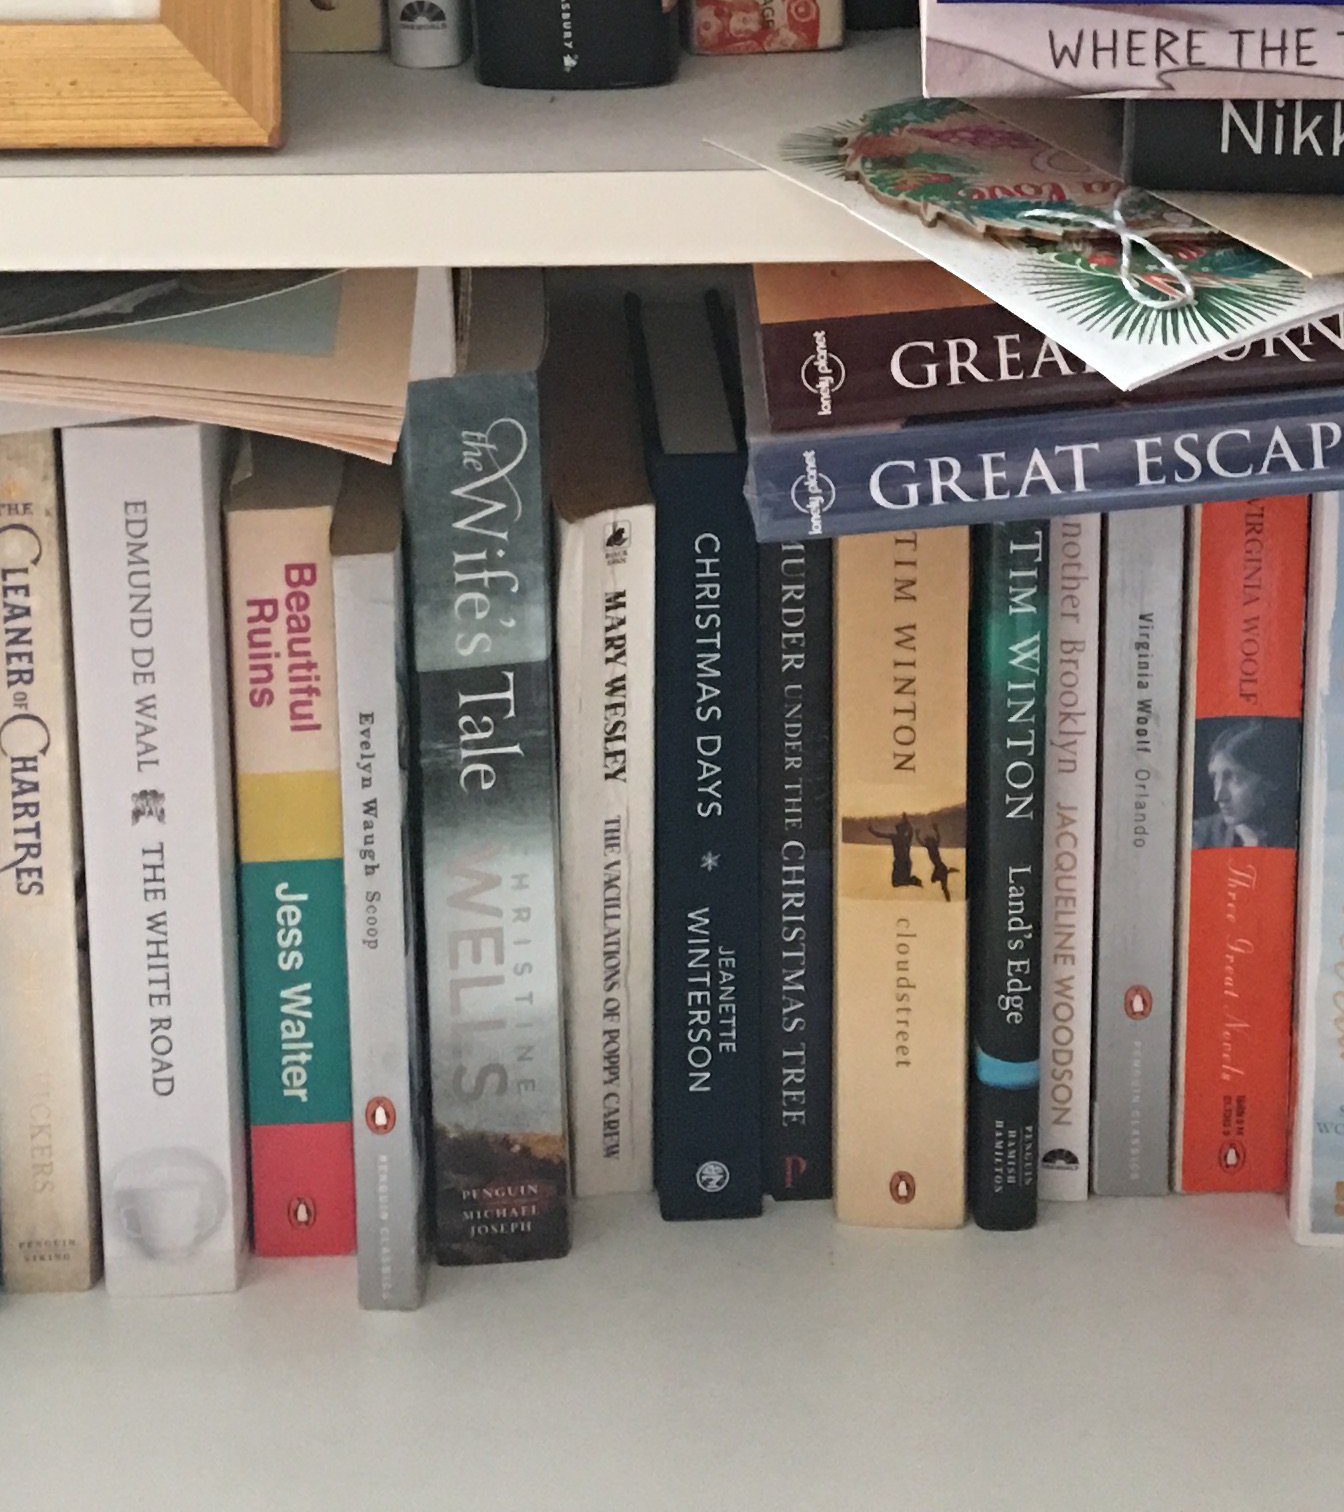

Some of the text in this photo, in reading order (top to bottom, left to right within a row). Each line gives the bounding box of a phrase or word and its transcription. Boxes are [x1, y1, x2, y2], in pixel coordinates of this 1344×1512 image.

[1048, 27, 1208, 71] WHERE
[1229, 27, 1319, 69] THE
[868, 439, 1102, 512] GREAT
[124, 499, 160, 773] EDMUND DE WAAL
[246, 597, 282, 709] Ruins
[284, 562, 323, 733] Beautiful
[604, 588, 627, 667] MARY
[694, 532, 722, 818] CHRISTMAS DAYS
[892, 532, 918, 774] TIM WINTON
[1006, 530, 1043, 820] TIM WINTON
[456, 670, 526, 794] Tale
[603, 674, 627, 785] WESLEY
[1049, 639, 1087, 775] Brooklyn
[1133, 611, 1155, 849] Virginia Woolf Orlando
[358, 711, 382, 951] Evelyn Waugh Scoop
[780, 683, 806, 1128] UNDER THE CHRISTMAS TREE
[142, 843, 175, 1097] THE WHITE ROAD
[275, 881, 314, 1104] Jess Walter
[602, 859, 622, 1161] VACILLATIONS POPPY CAREW
[687, 906, 712, 1093] WINTERSON
[717, 945, 738, 1053] JEANETTE
[894, 916, 917, 1069] cloudstreet
[997, 958, 1031, 1025] Edge
[1050, 974, 1076, 1127] WOODSON
[461, 1183, 539, 1200] PENGUIN
[462, 1205, 540, 1220] MICHAEL
[469, 1220, 532, 1238] JOSEPH
